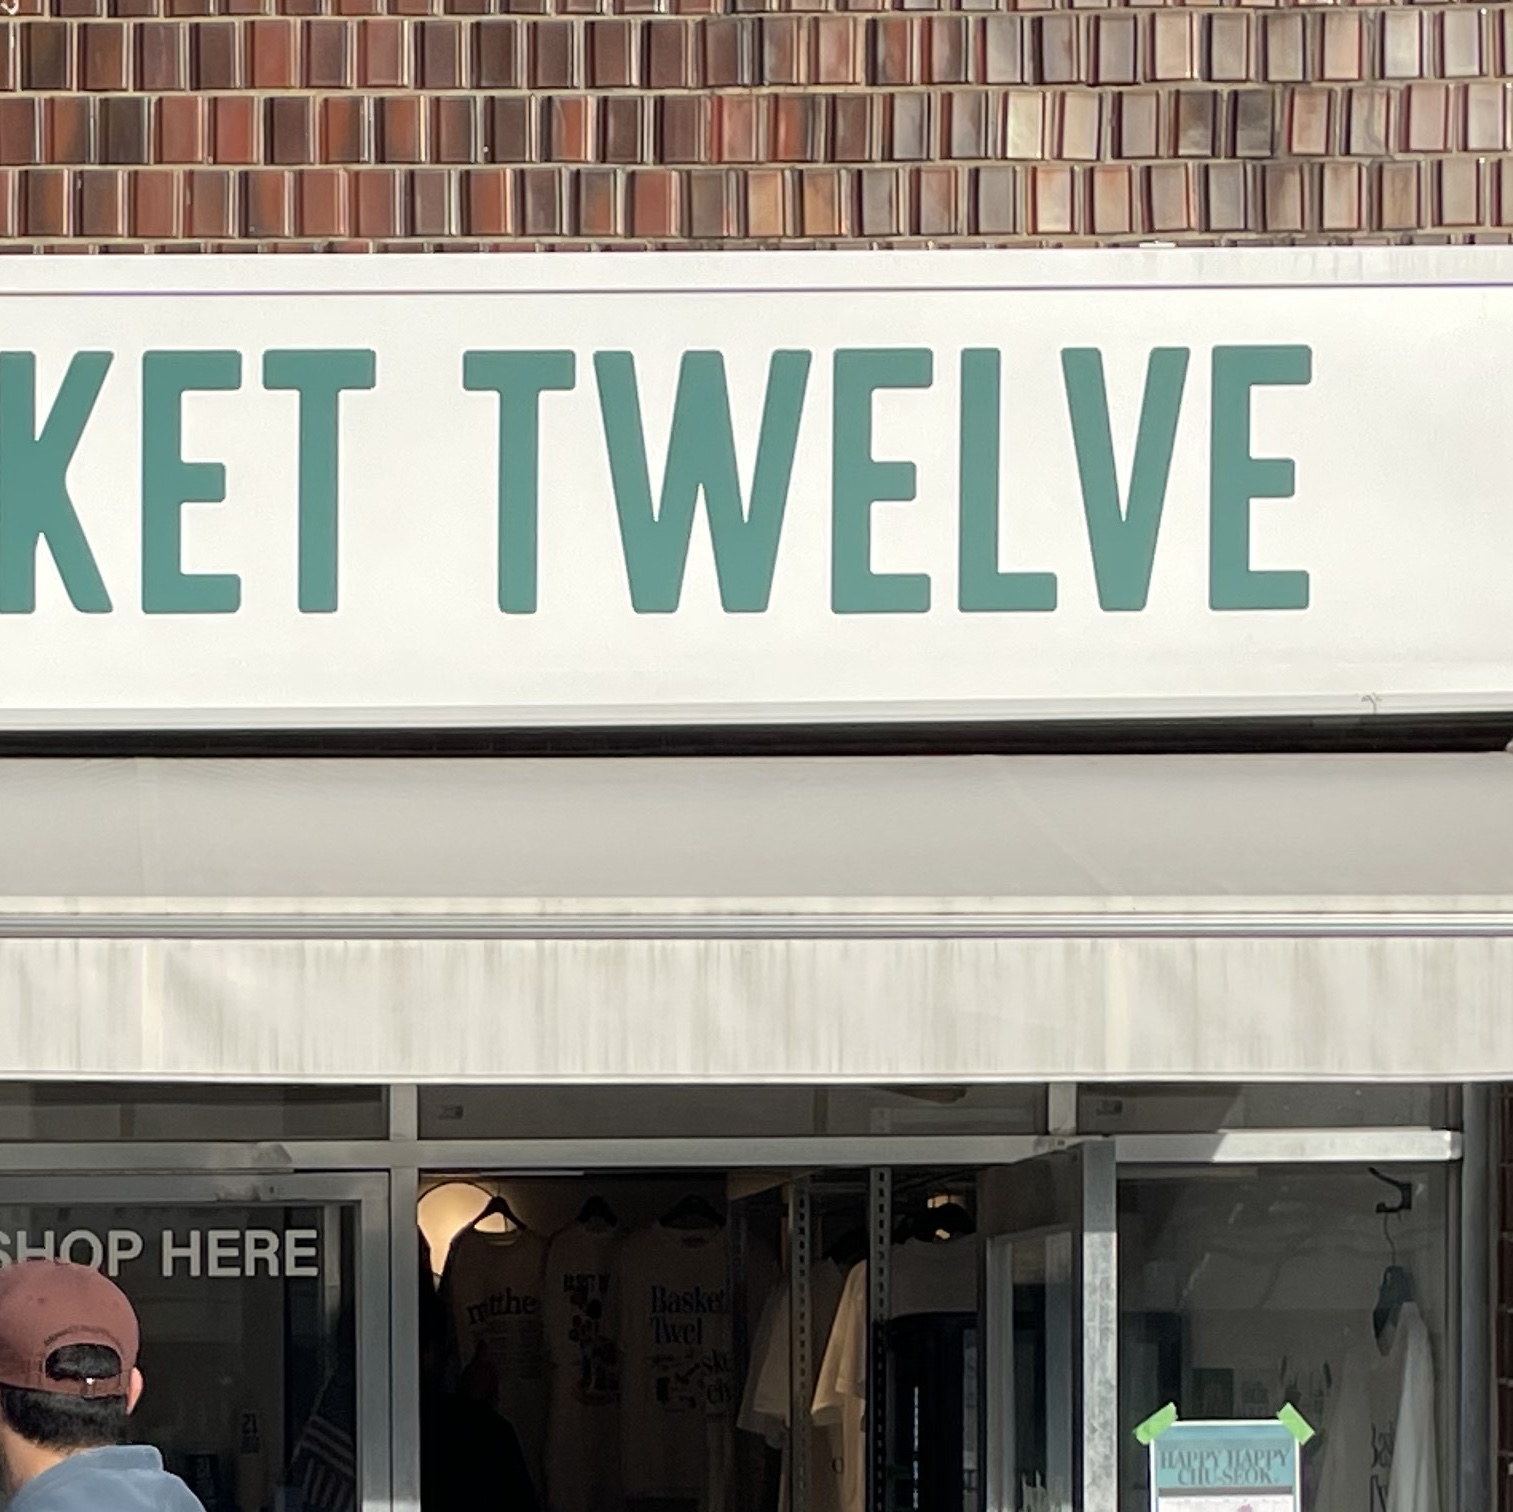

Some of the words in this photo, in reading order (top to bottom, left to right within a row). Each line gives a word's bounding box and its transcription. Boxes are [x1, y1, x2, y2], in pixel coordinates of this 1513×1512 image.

[462, 345, 1314, 614] TWELVE
[161, 1229, 320, 1278] HERE
[1159, 1449, 1221, 1469] HAPPY
[1222, 1448, 1289, 1469] HAPPY
